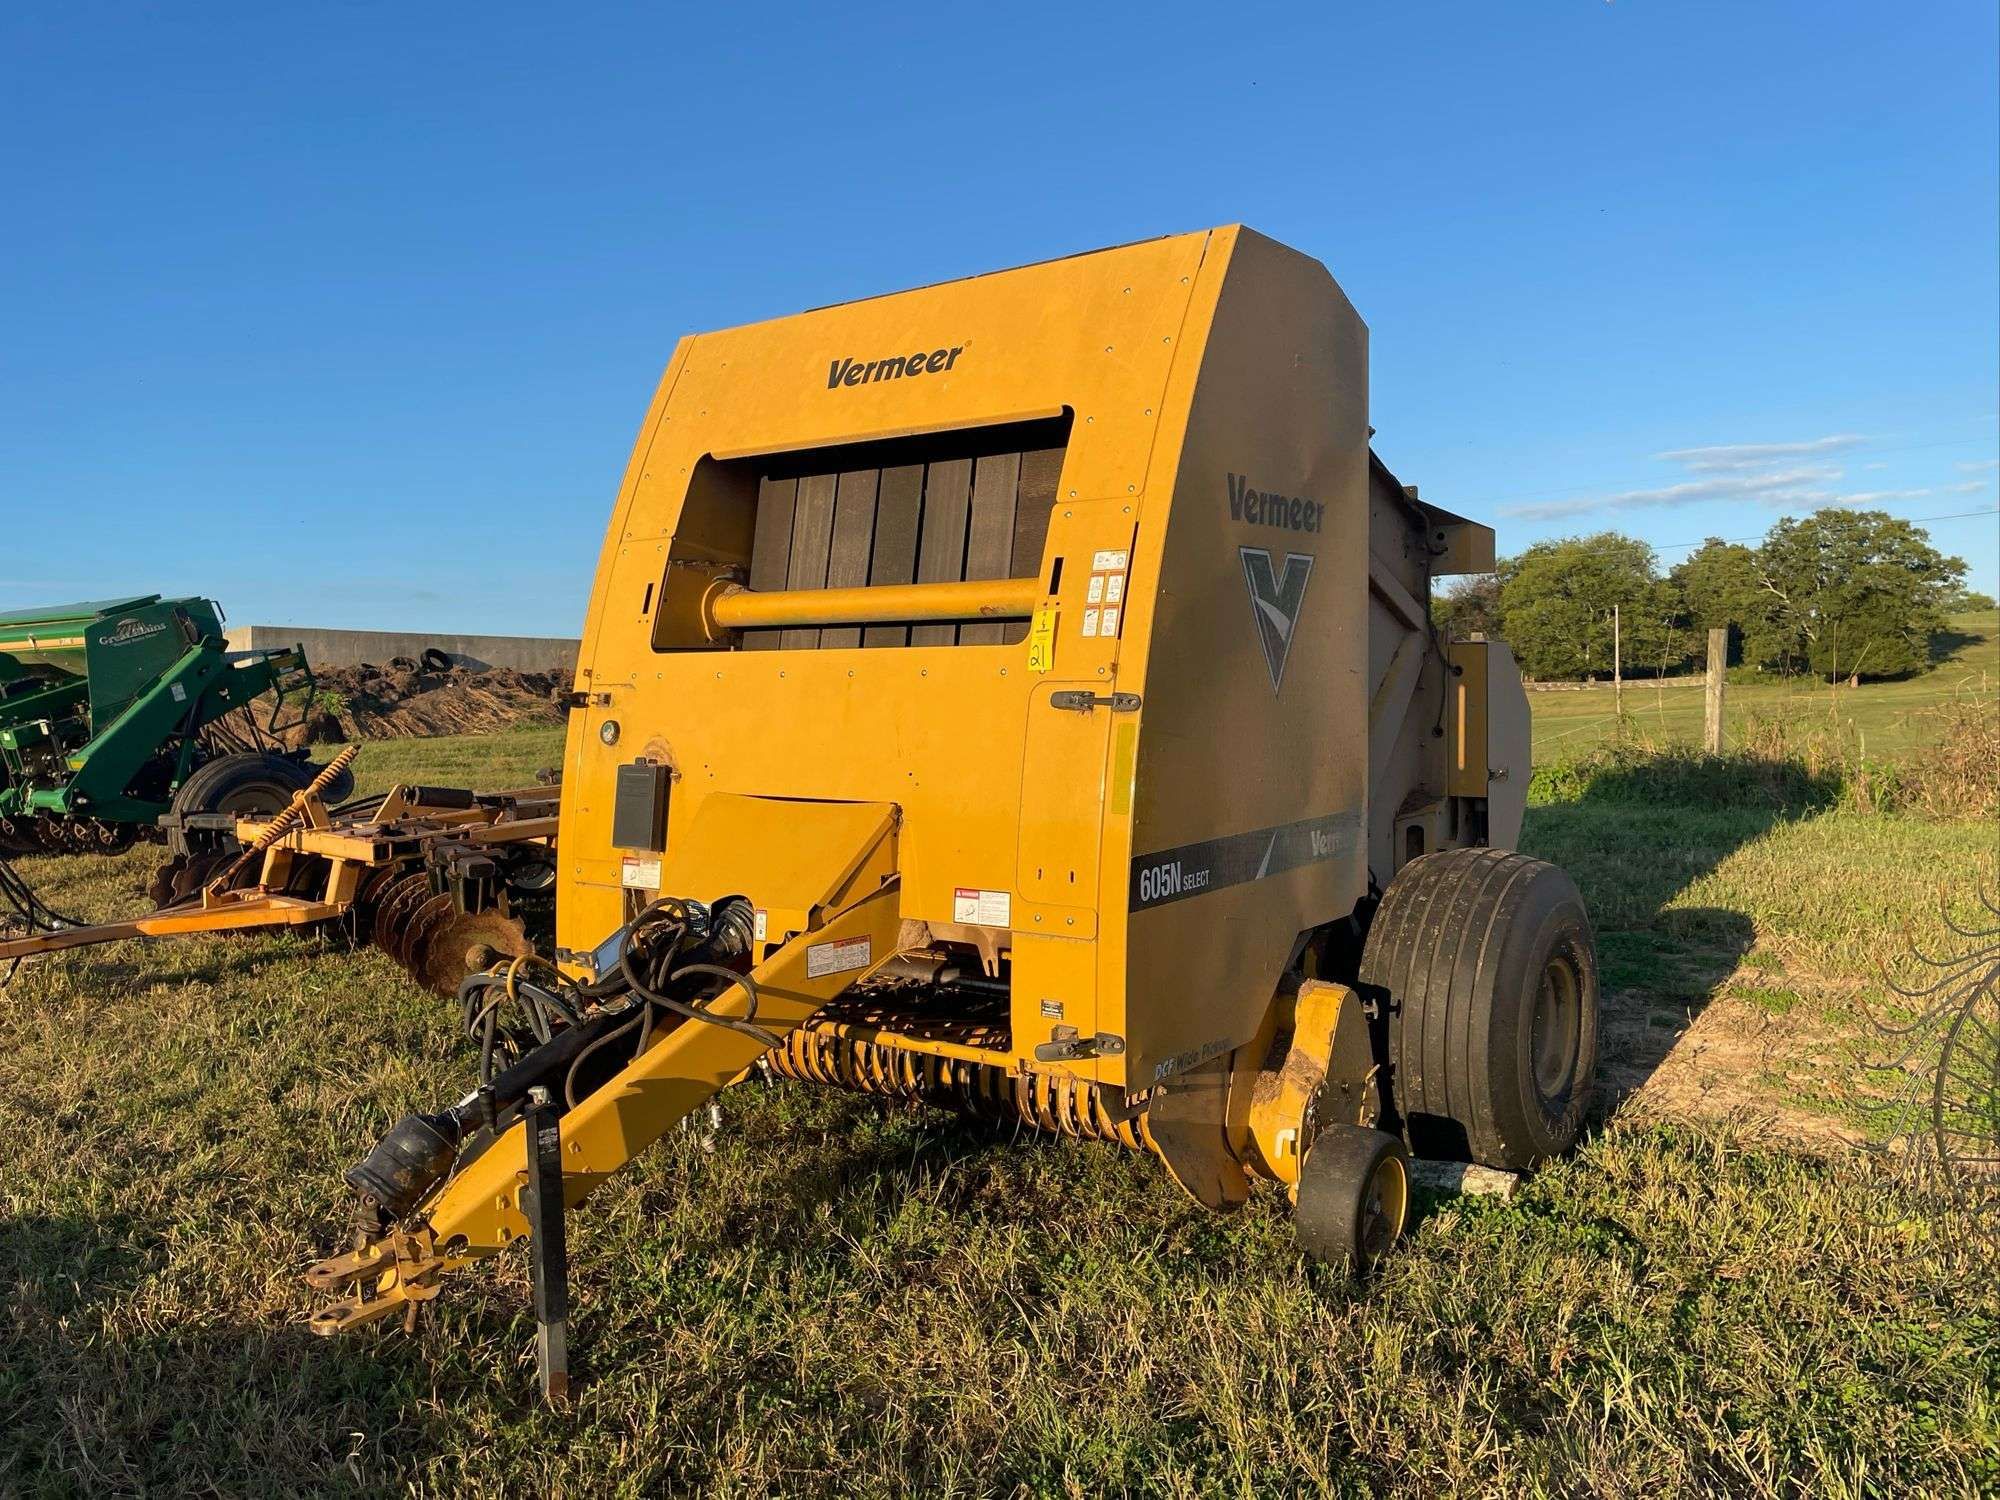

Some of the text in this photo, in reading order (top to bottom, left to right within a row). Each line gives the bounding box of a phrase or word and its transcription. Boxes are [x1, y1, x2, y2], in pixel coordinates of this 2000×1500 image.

[827, 346, 964, 389] Vermeer
[1227, 472, 1325, 533] Vermeer
[1140, 861, 1210, 902] 605N SELECT
